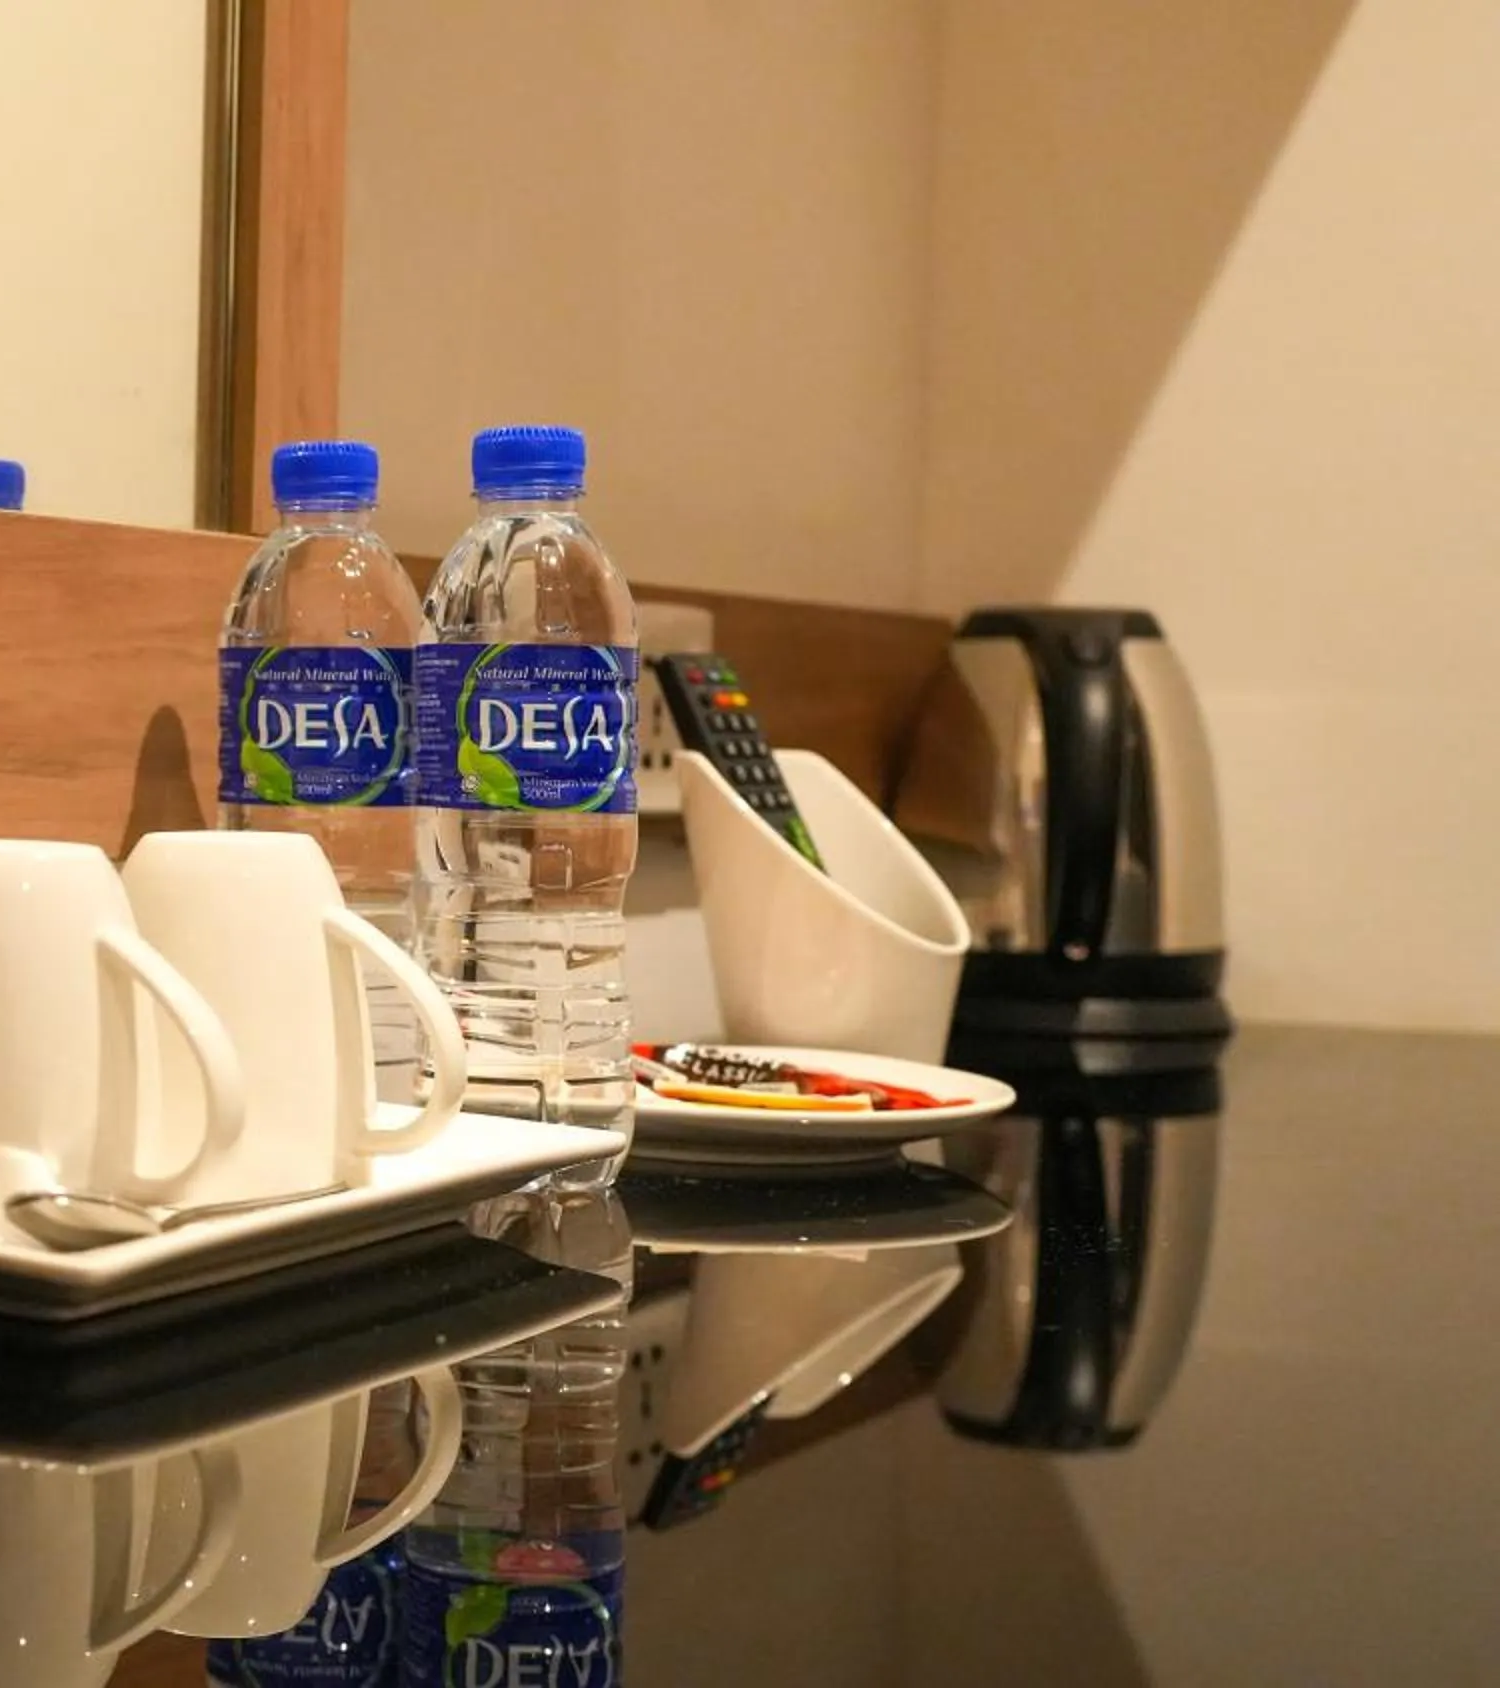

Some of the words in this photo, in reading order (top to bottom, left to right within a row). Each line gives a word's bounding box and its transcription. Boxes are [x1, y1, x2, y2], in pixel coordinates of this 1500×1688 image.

[254, 667, 300, 681] Natural
[304, 667, 358, 681] Mineral
[475, 666, 529, 681] Natural
[533, 667, 588, 681] Mineral
[258, 695, 388, 759] DESA
[479, 695, 613, 760] DESA
